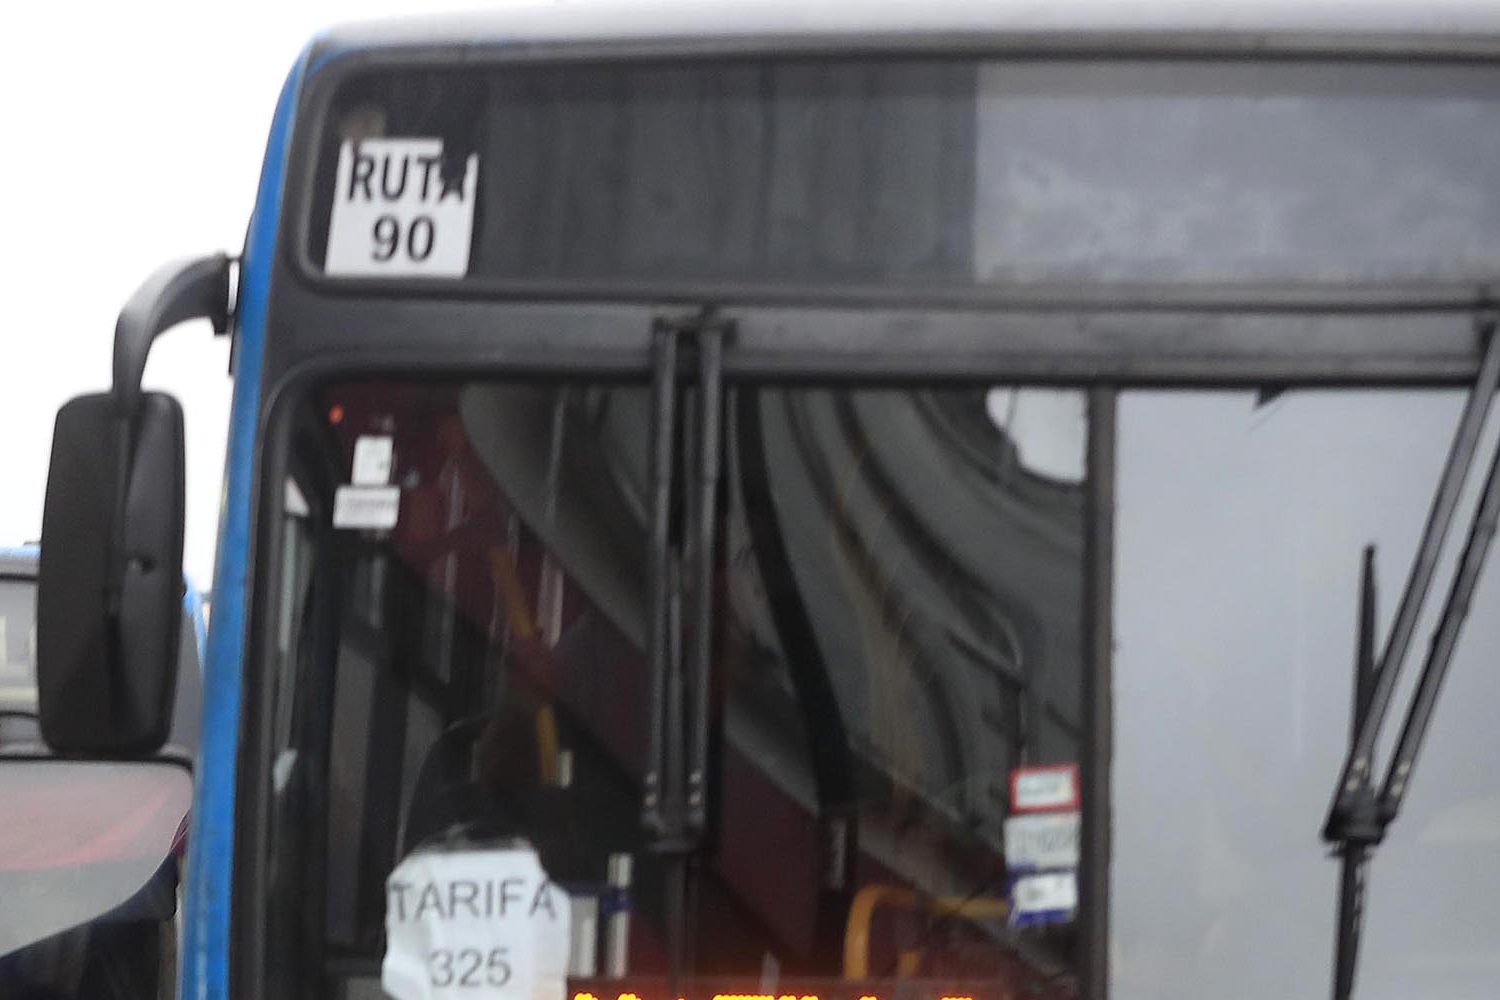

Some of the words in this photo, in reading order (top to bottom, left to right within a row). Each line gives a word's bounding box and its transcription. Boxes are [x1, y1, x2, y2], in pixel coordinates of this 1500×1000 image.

[370, 215, 435, 263] 90
[391, 878, 558, 922] TARIFA
[431, 948, 512, 989] 325
